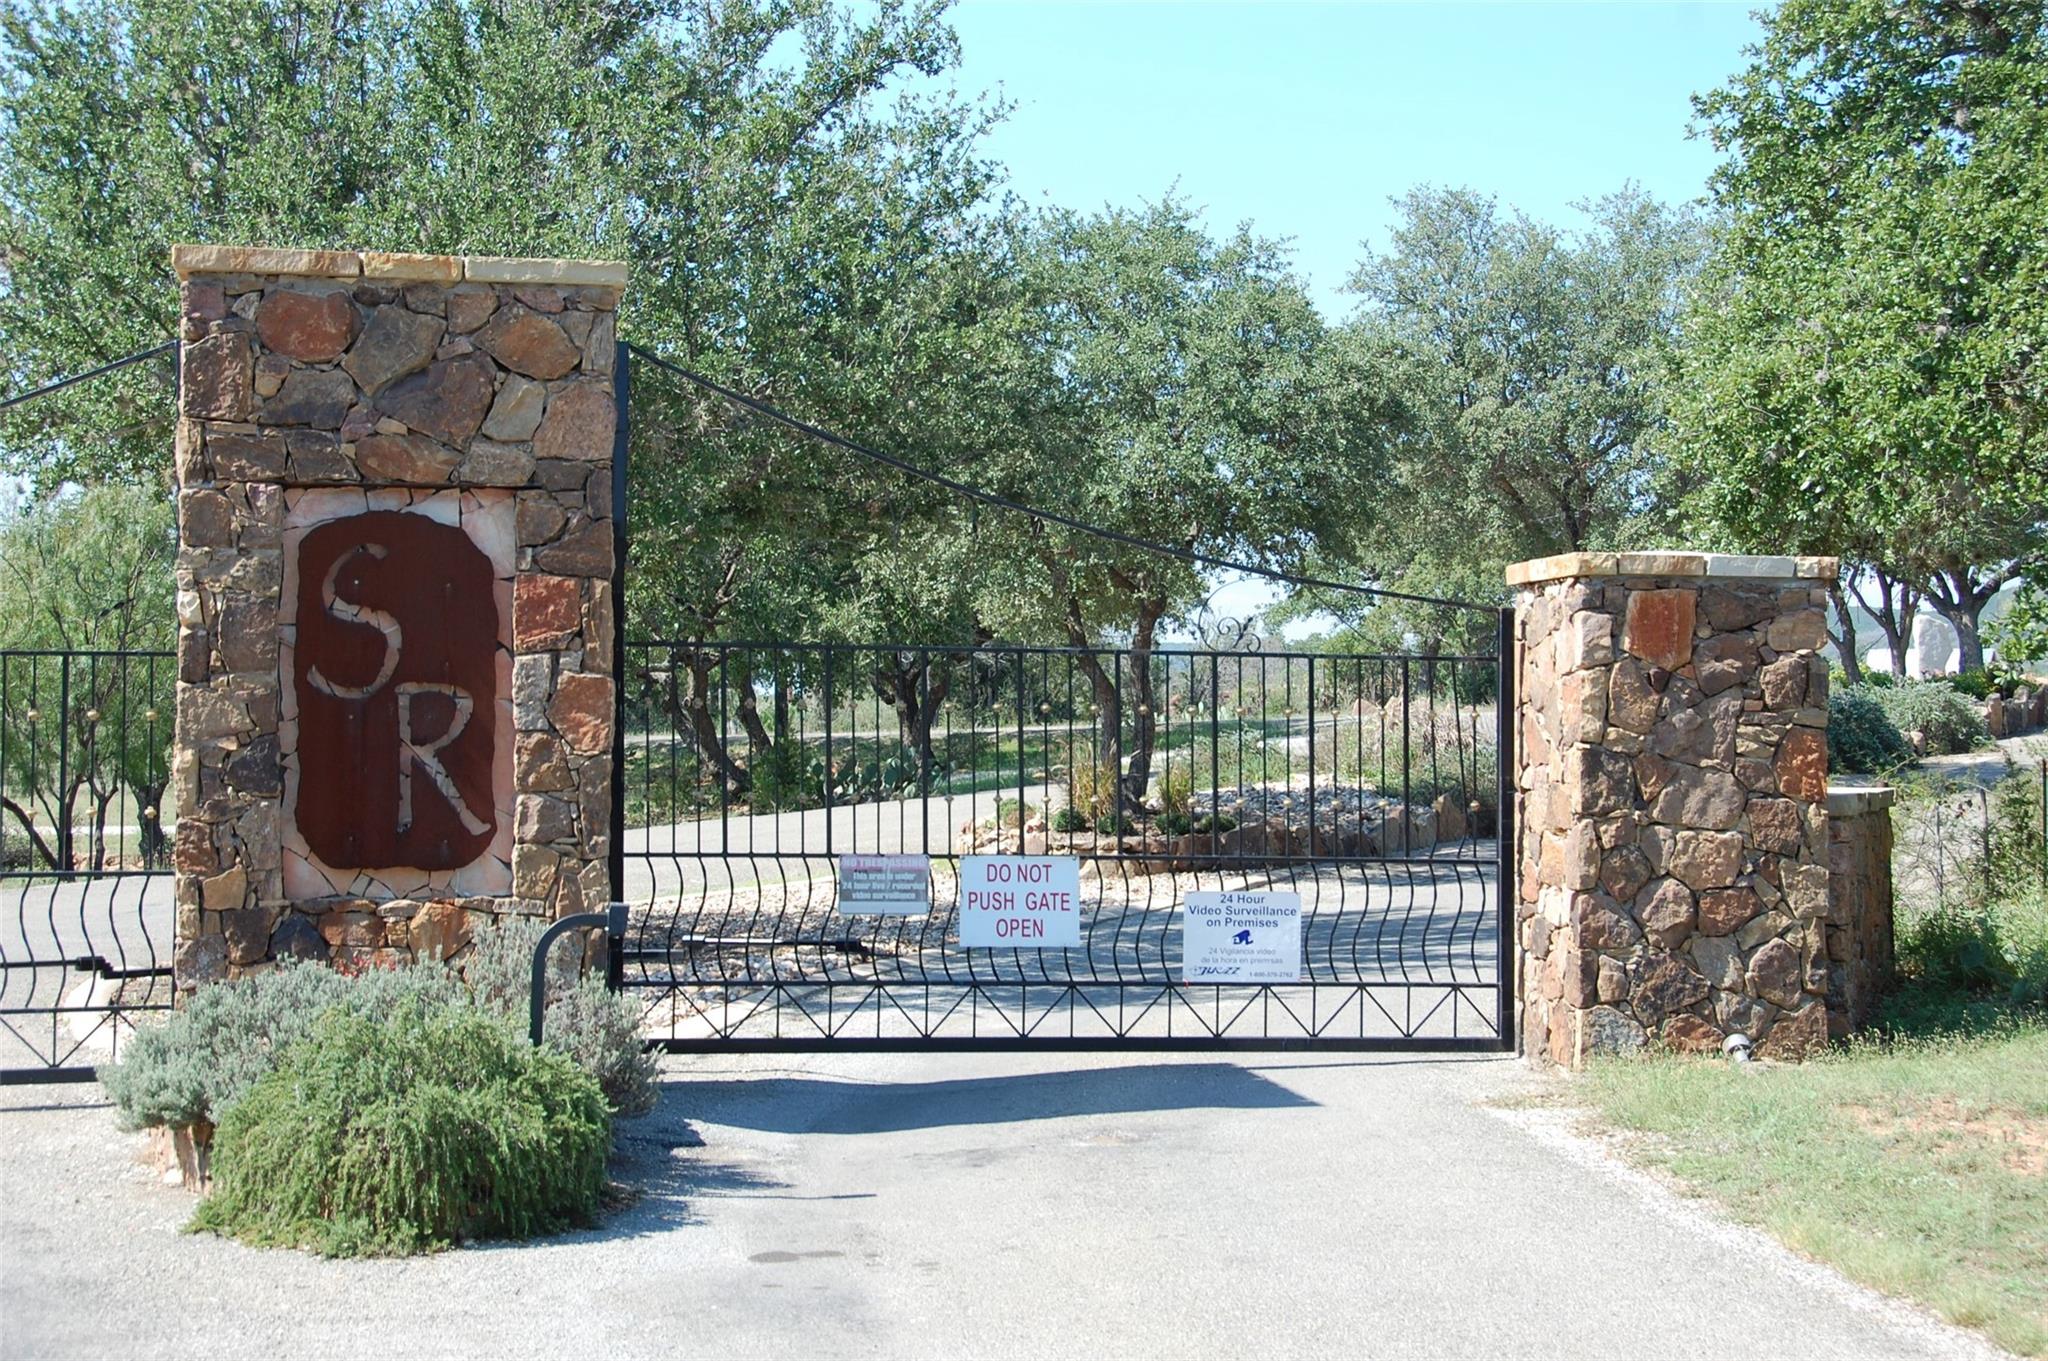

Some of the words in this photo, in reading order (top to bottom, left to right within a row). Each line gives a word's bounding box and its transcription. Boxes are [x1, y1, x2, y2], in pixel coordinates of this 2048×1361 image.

[842, 857, 856, 867] NO
[859, 857, 928, 868] TRESPASSING
[895, 872, 916, 880] under
[987, 864, 1011, 882] DO
[1017, 864, 1052, 883] NOT
[842, 882, 852, 890] 24
[854, 882, 870, 890] hour
[892, 882, 926, 890] recorded
[852, 891, 871, 899] video
[872, 891, 916, 900] surveillance
[1220, 894, 1233, 904] 24
[1237, 894, 1265, 904] Hour
[968, 892, 1014, 911] PUSH
[1025, 892, 1071, 911] GATE
[1189, 905, 1222, 916] Video
[1225, 905, 1297, 916] Surveillance
[996, 919, 1044, 937] OPEN
[1206, 919, 1221, 928] on
[1224, 917, 1279, 928] Premises
